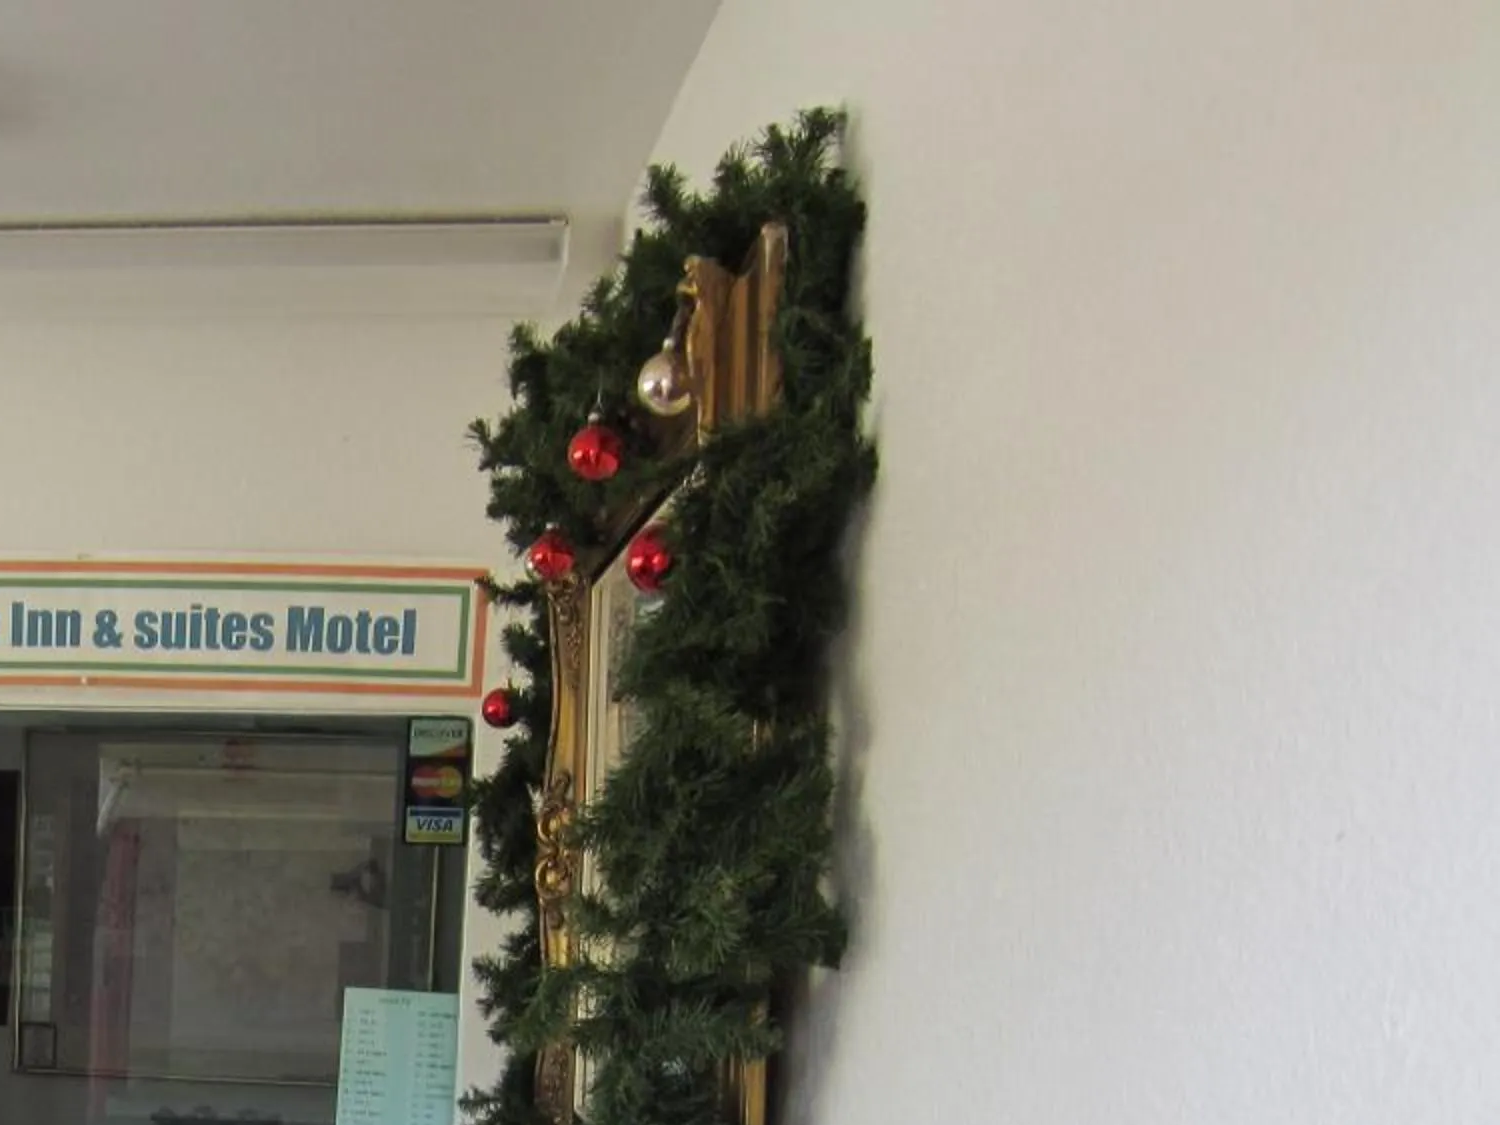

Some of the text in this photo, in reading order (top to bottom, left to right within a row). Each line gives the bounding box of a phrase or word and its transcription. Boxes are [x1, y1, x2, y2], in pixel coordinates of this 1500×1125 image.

[11, 601, 82, 648] Inn
[93, 608, 123, 649] &
[133, 603, 275, 651] suites
[286, 605, 417, 655] Motel
[416, 818, 453, 832] VISA
